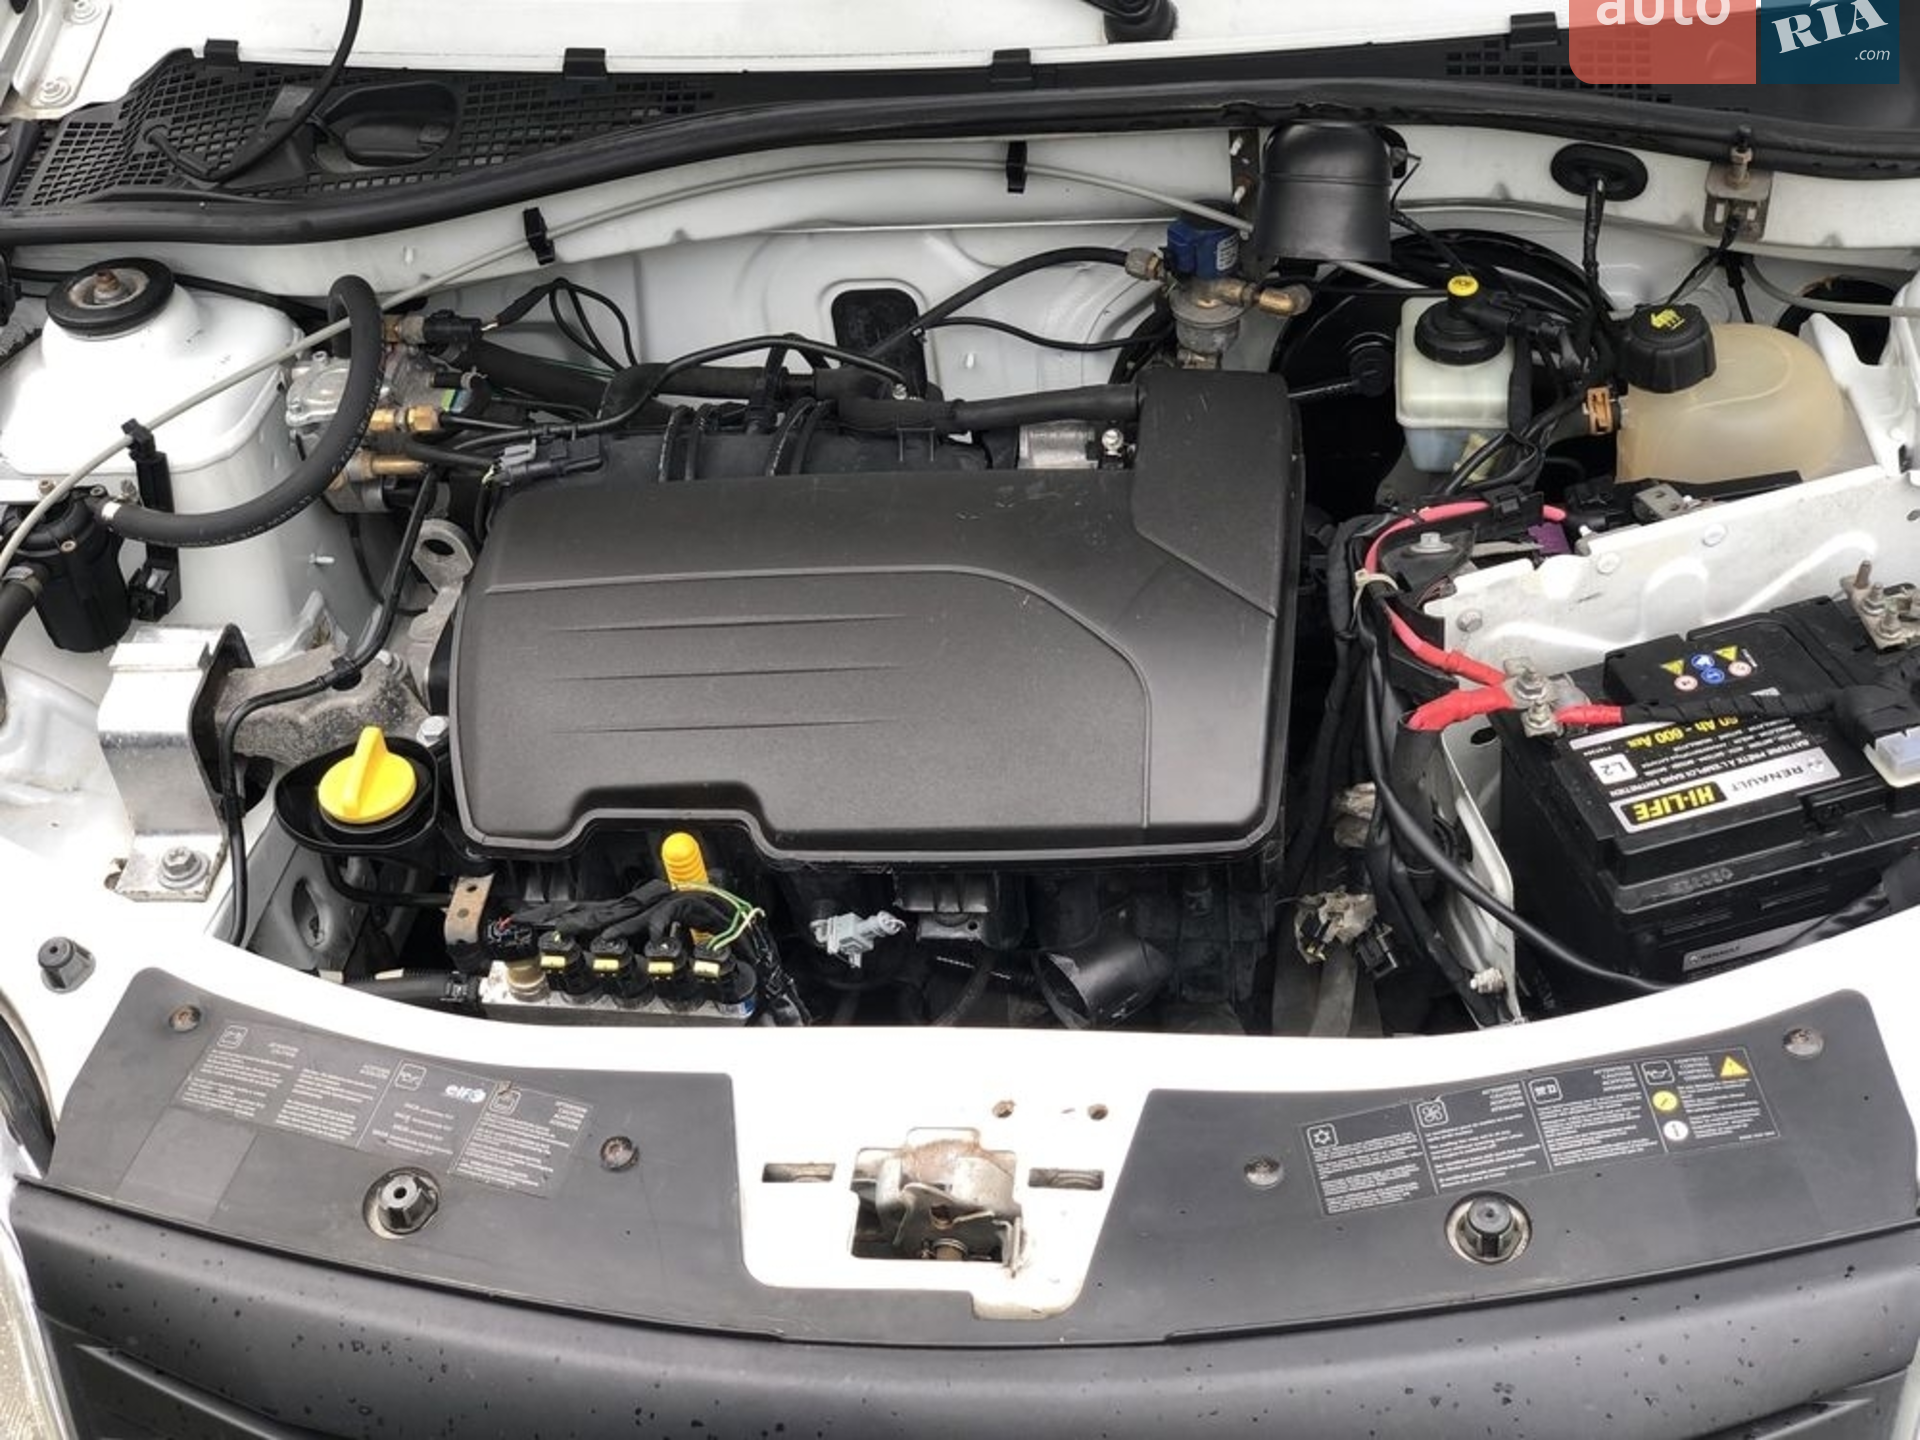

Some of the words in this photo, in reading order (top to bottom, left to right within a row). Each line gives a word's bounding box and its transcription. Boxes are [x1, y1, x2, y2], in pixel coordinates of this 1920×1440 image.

[1694, 719, 1715, 732] Ah
[1654, 727, 1685, 743] 600
[1600, 762, 1627, 776] L2
[1730, 765, 1804, 791] RENAULT
[1632, 785, 1716, 821] HI-LIFE
